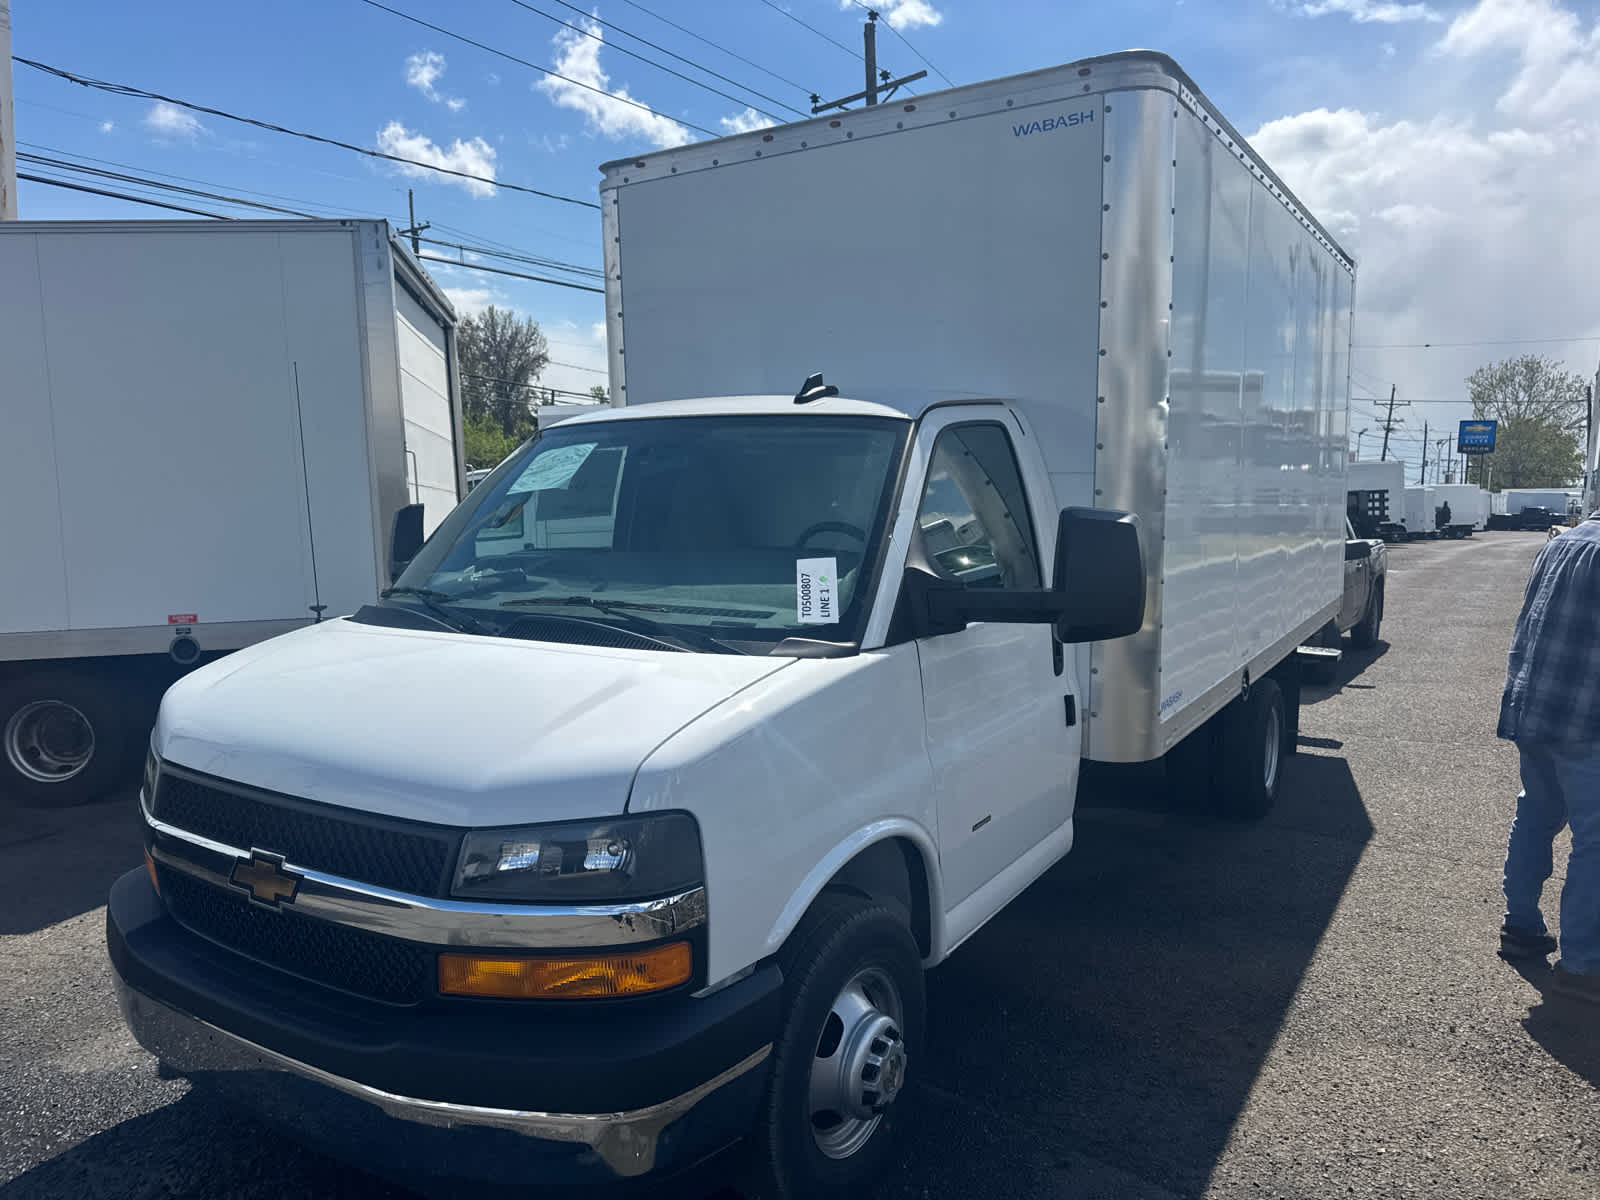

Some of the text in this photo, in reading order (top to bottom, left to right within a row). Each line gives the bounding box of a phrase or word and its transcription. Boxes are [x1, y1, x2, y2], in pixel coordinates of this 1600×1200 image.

[1012, 109, 1094, 137] WABASH
[801, 573, 812, 618] T0500807
[820, 597, 830, 618] LINE
